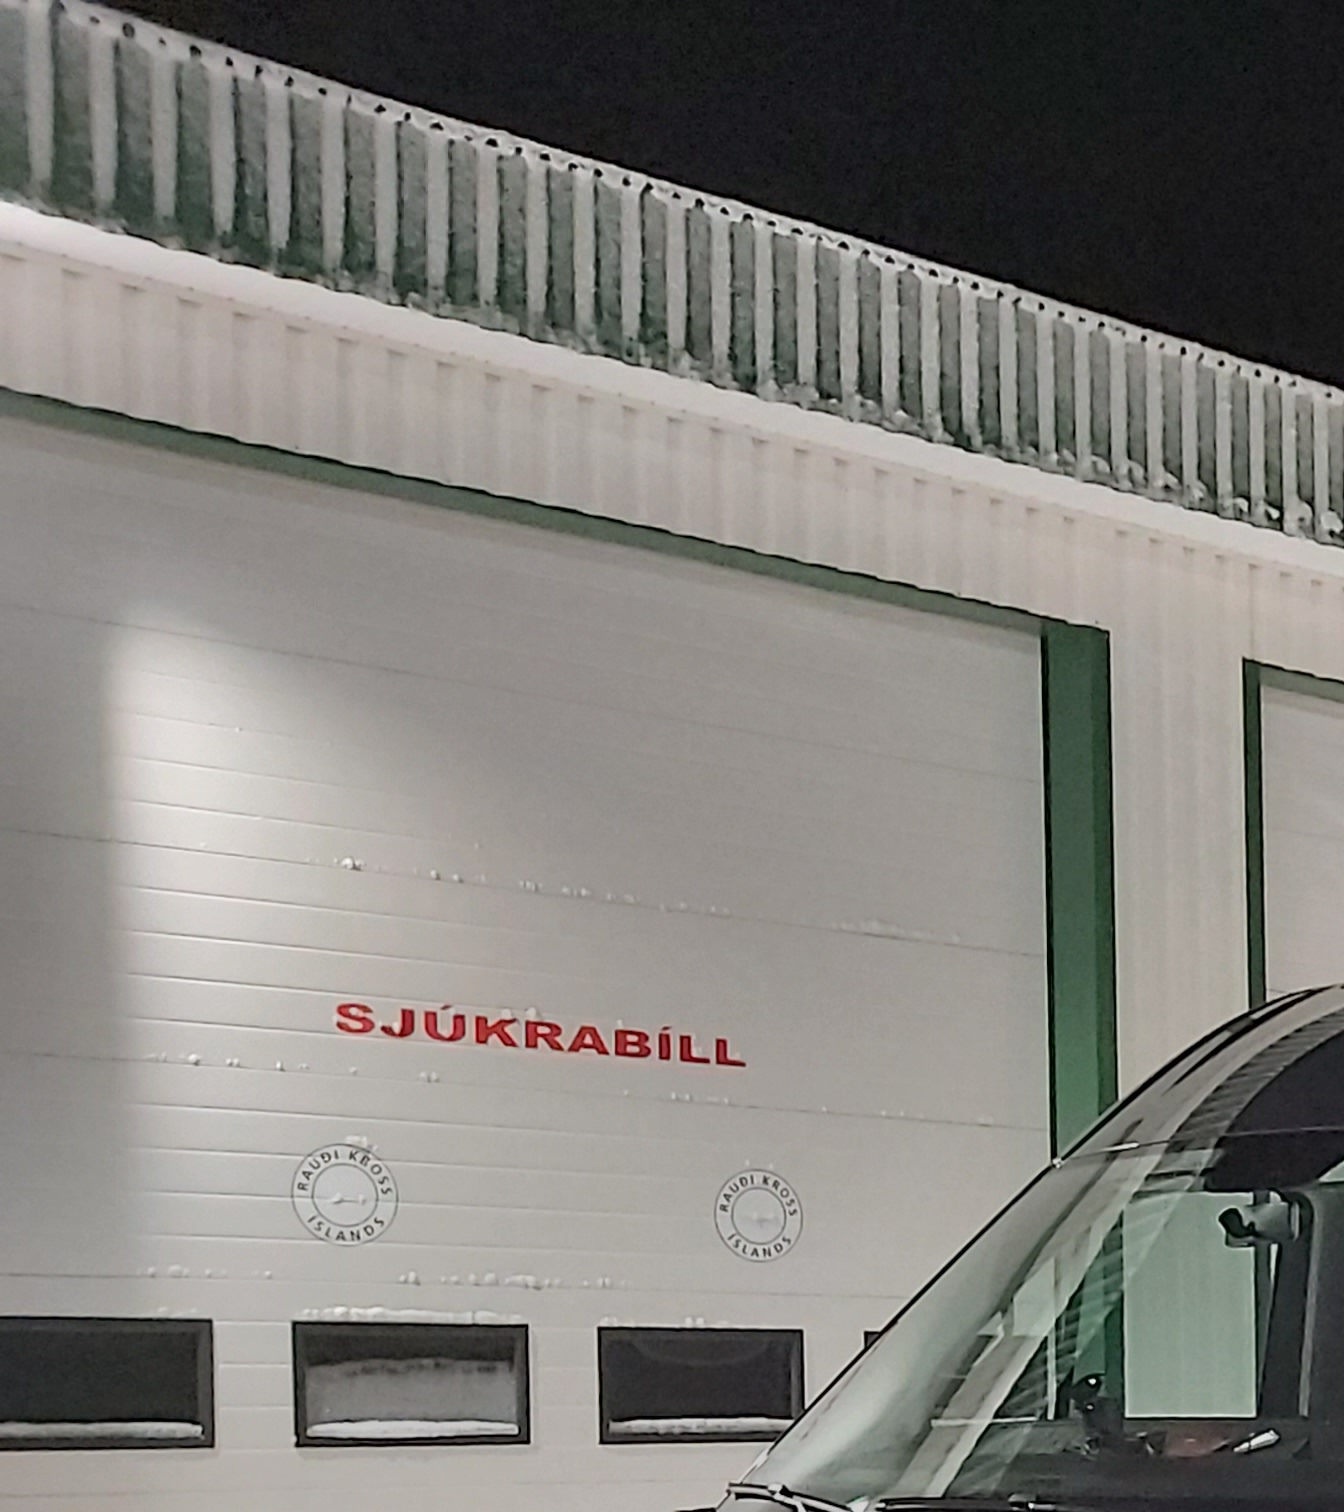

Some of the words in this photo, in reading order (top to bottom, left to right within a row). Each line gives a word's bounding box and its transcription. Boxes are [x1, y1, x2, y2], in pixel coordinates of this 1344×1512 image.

[335, 1003, 747, 1068] SJÚKRABÍLL
[348, 1150, 392, 1195] KROSS
[762, 1175, 797, 1216] KROSS
